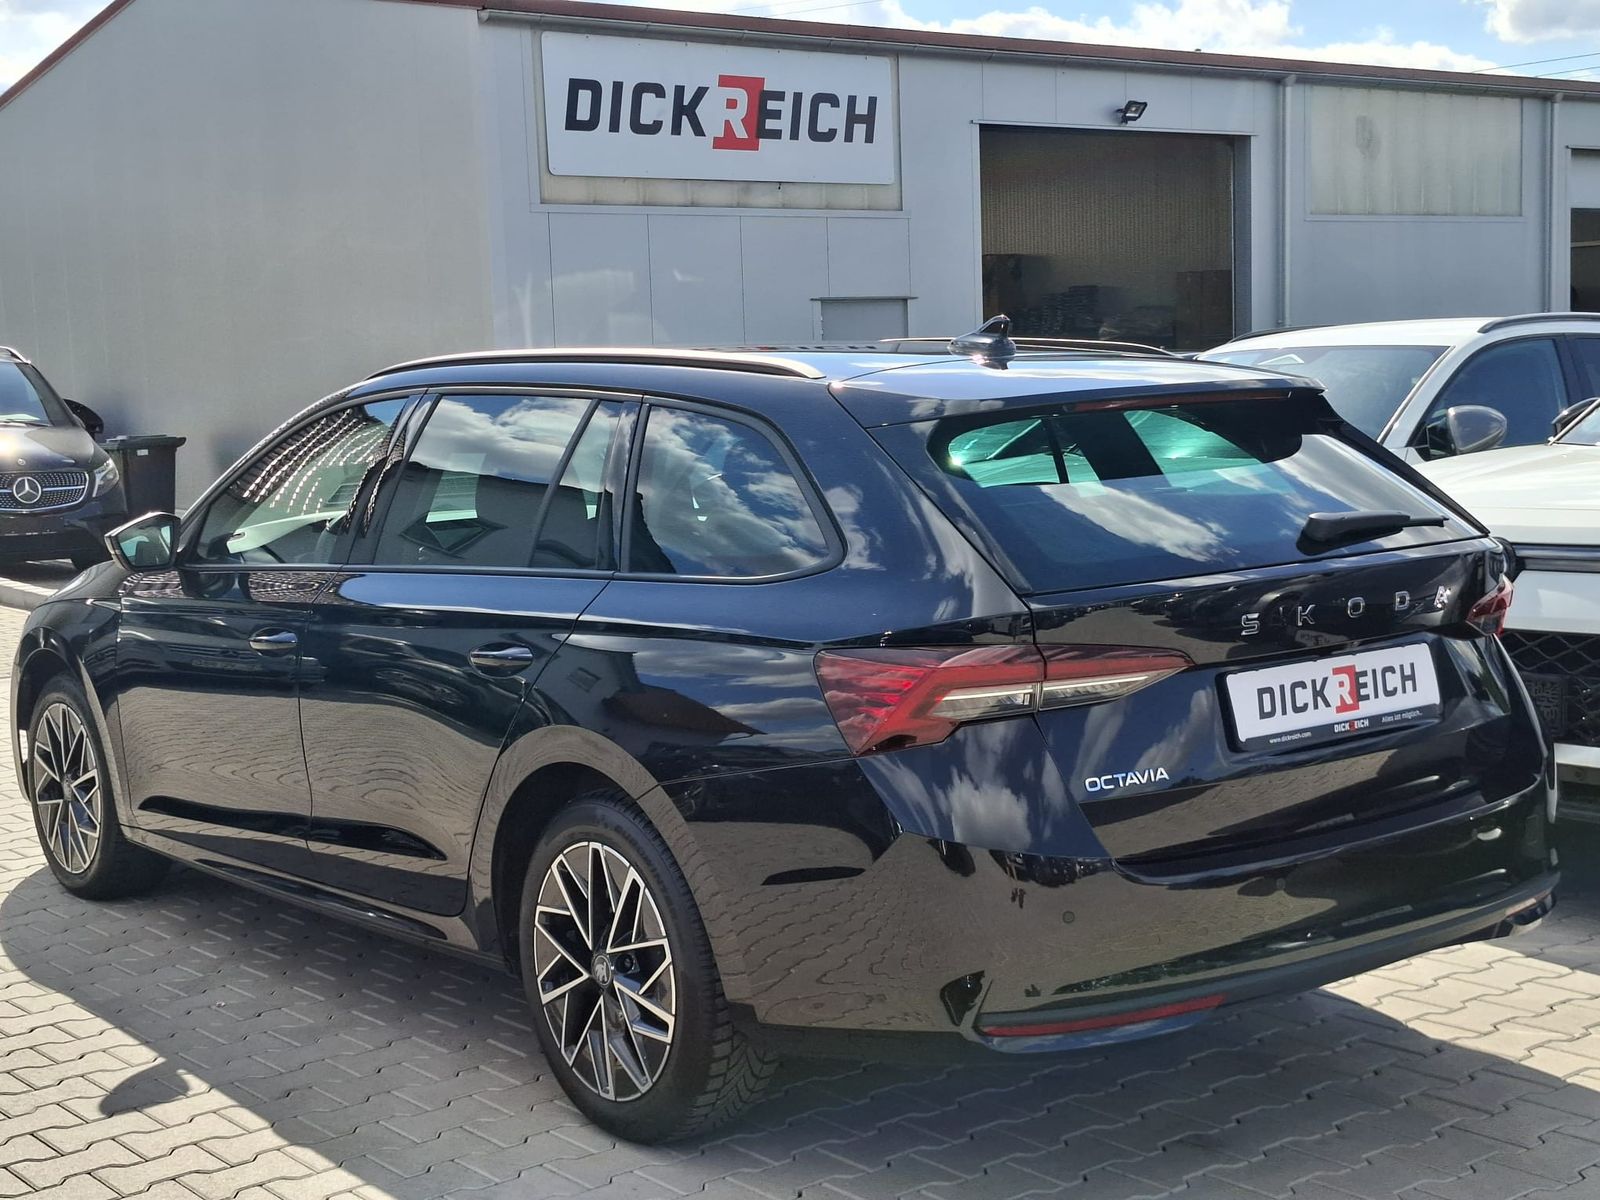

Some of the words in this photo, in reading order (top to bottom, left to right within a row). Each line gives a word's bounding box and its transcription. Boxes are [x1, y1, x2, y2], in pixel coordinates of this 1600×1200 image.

[564, 75, 878, 151] DICKREICH
[1257, 662, 1417, 719] DICKREICH
[1085, 767, 1170, 792] OCTAVIA
